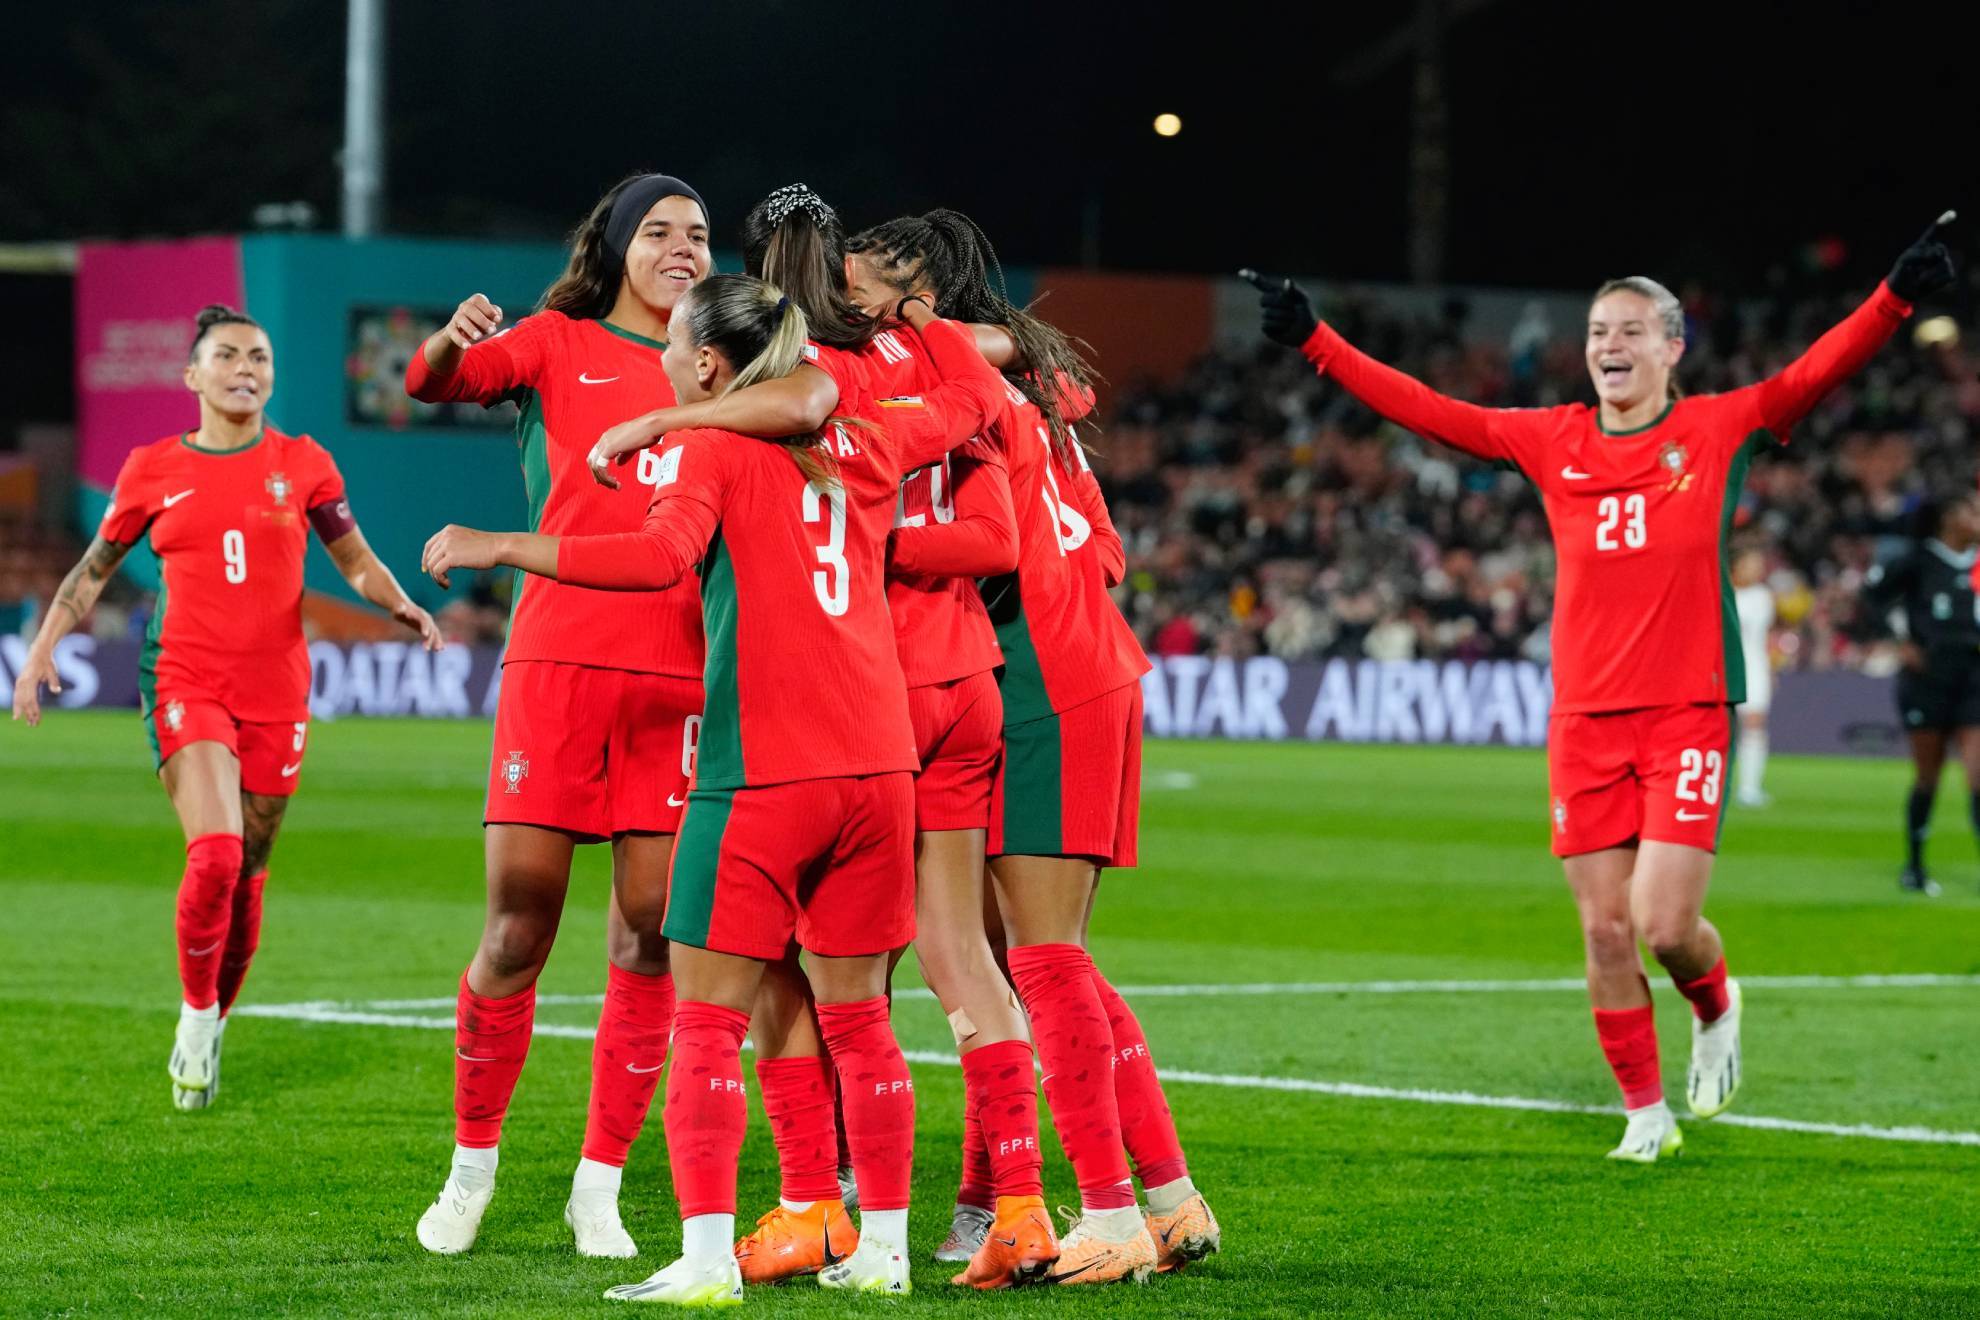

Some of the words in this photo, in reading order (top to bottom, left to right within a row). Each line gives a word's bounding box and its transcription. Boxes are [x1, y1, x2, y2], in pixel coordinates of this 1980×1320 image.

[802, 477, 850, 617] 3
[1596, 494, 1647, 551] 23
[223, 529, 247, 585] 9
[309, 640, 471, 723] QATAR
[1675, 748, 1722, 805] 23
